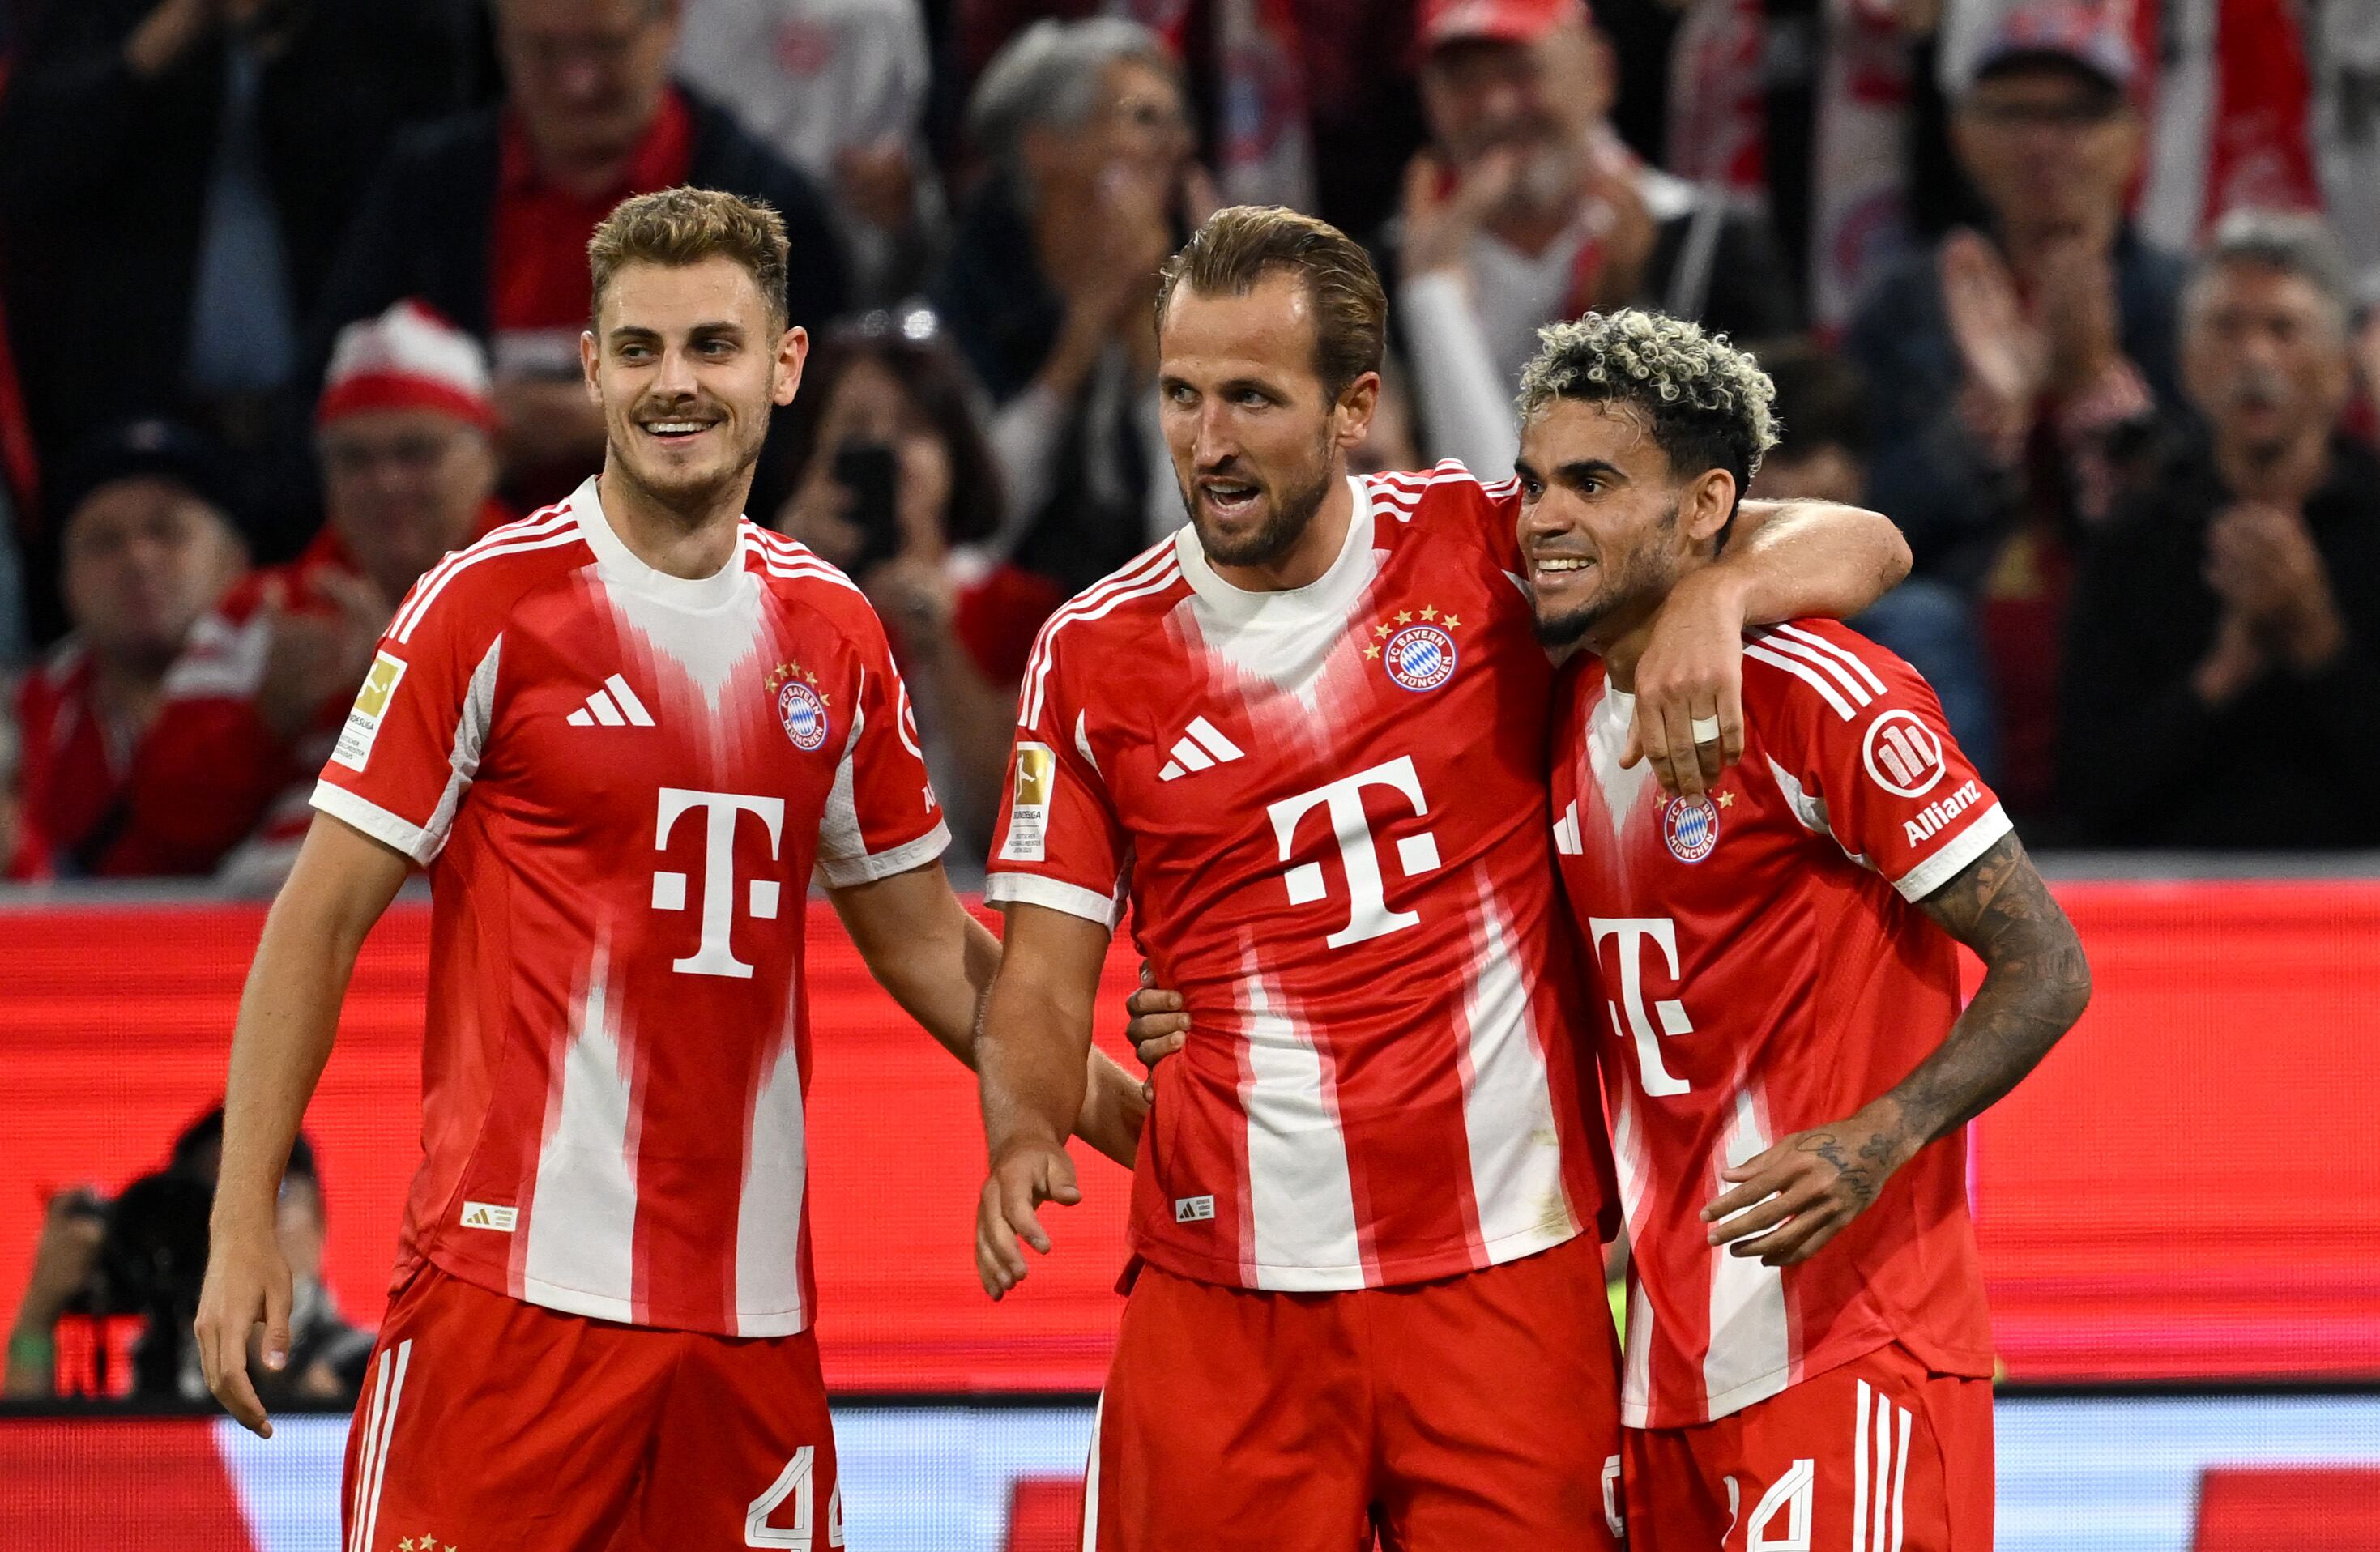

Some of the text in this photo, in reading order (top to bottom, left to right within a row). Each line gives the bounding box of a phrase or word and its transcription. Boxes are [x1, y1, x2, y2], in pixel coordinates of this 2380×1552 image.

[1390, 630, 1446, 663] FC BAYERN
[781, 688, 821, 714] FC BAYERN
[1669, 799, 1714, 822] FC BRN
[1902, 779, 1982, 849] Allianz
[651, 787, 785, 979] T
[1266, 754, 1441, 949] T
[1589, 917, 1694, 1098] T
